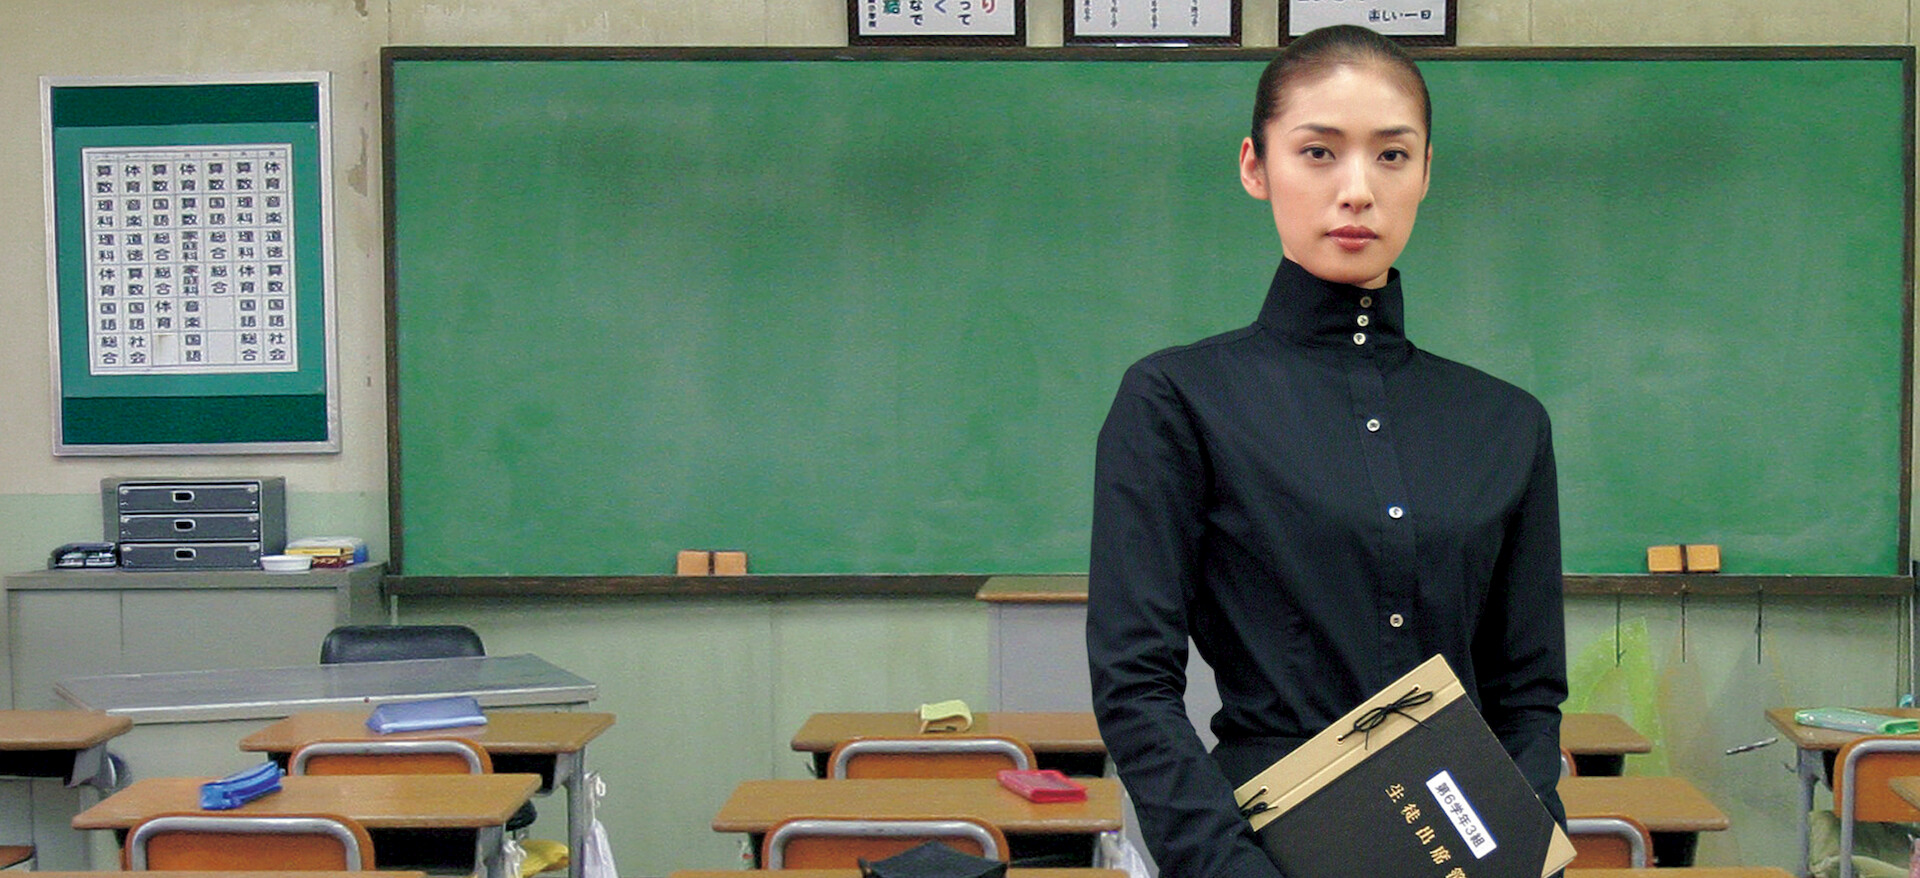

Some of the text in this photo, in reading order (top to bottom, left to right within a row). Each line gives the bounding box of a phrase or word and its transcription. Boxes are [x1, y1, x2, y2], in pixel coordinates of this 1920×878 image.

[96, 166, 113, 194] 算数
[124, 166, 141, 193] 体育
[152, 165, 168, 192] 算数
[179, 164, 196, 191] 体育
[208, 163, 225, 191] 算数
[236, 162, 253, 190] 算数
[264, 162, 280, 190] 体育
[97, 200, 114, 227] 理科
[152, 199, 169, 226] 国語
[181, 198, 197, 226] 算数
[208, 198, 225, 225] 国語
[237, 197, 253, 223] 理科
[99, 235, 115, 261] 理科
[238, 231, 254, 257] 理科
[99, 269, 115, 296] 体育
[127, 268, 144, 296] 算数
[238, 266, 255, 293] 体育
[267, 265, 283, 292] 算数
[100, 303, 117, 331] 国語
[128, 303, 145, 330] 国語
[155, 302, 171, 329] 体育
[239, 300, 256, 327] 国語
[268, 300, 284, 327] 国語
[130, 337, 145, 364] 社会
[185, 335, 201, 362] 国語
[269, 334, 284, 361] 社会
[1435, 782, 1485, 848] 第6学年3組
